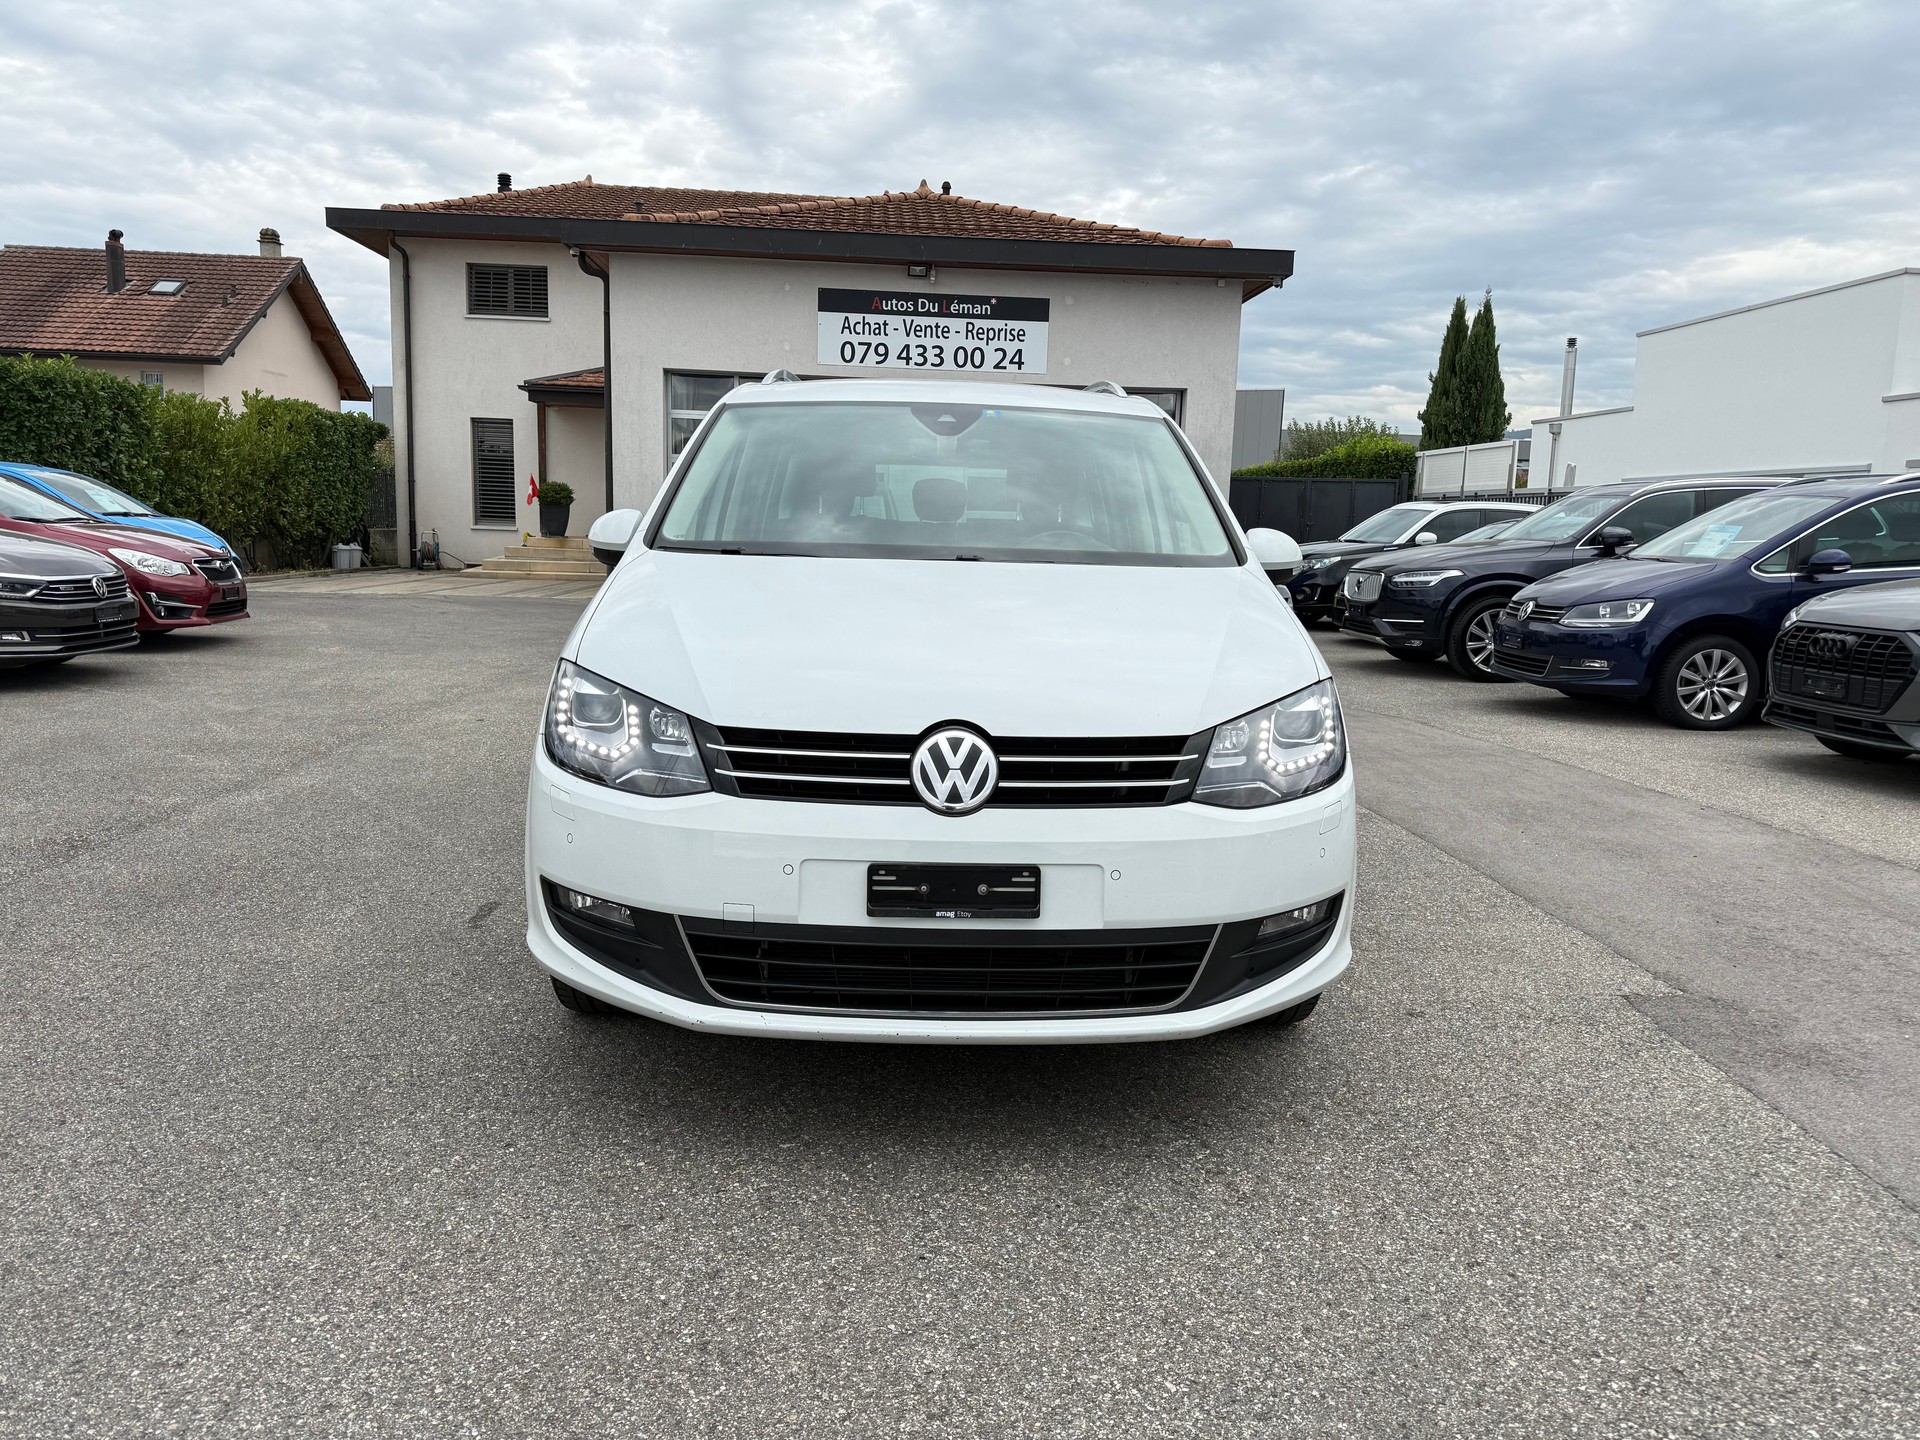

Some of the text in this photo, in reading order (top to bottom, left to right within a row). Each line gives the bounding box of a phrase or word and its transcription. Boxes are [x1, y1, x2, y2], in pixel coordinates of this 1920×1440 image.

[872, 296, 991, 315] Autos Du Léman
[841, 316, 889, 337] Achat
[902, 318, 951, 340] Vente
[965, 321, 1026, 346] Reprise
[840, 341, 1025, 371] 079 433 00 24
[915, 731, 994, 808] VW
[935, 911, 955, 919] amag
